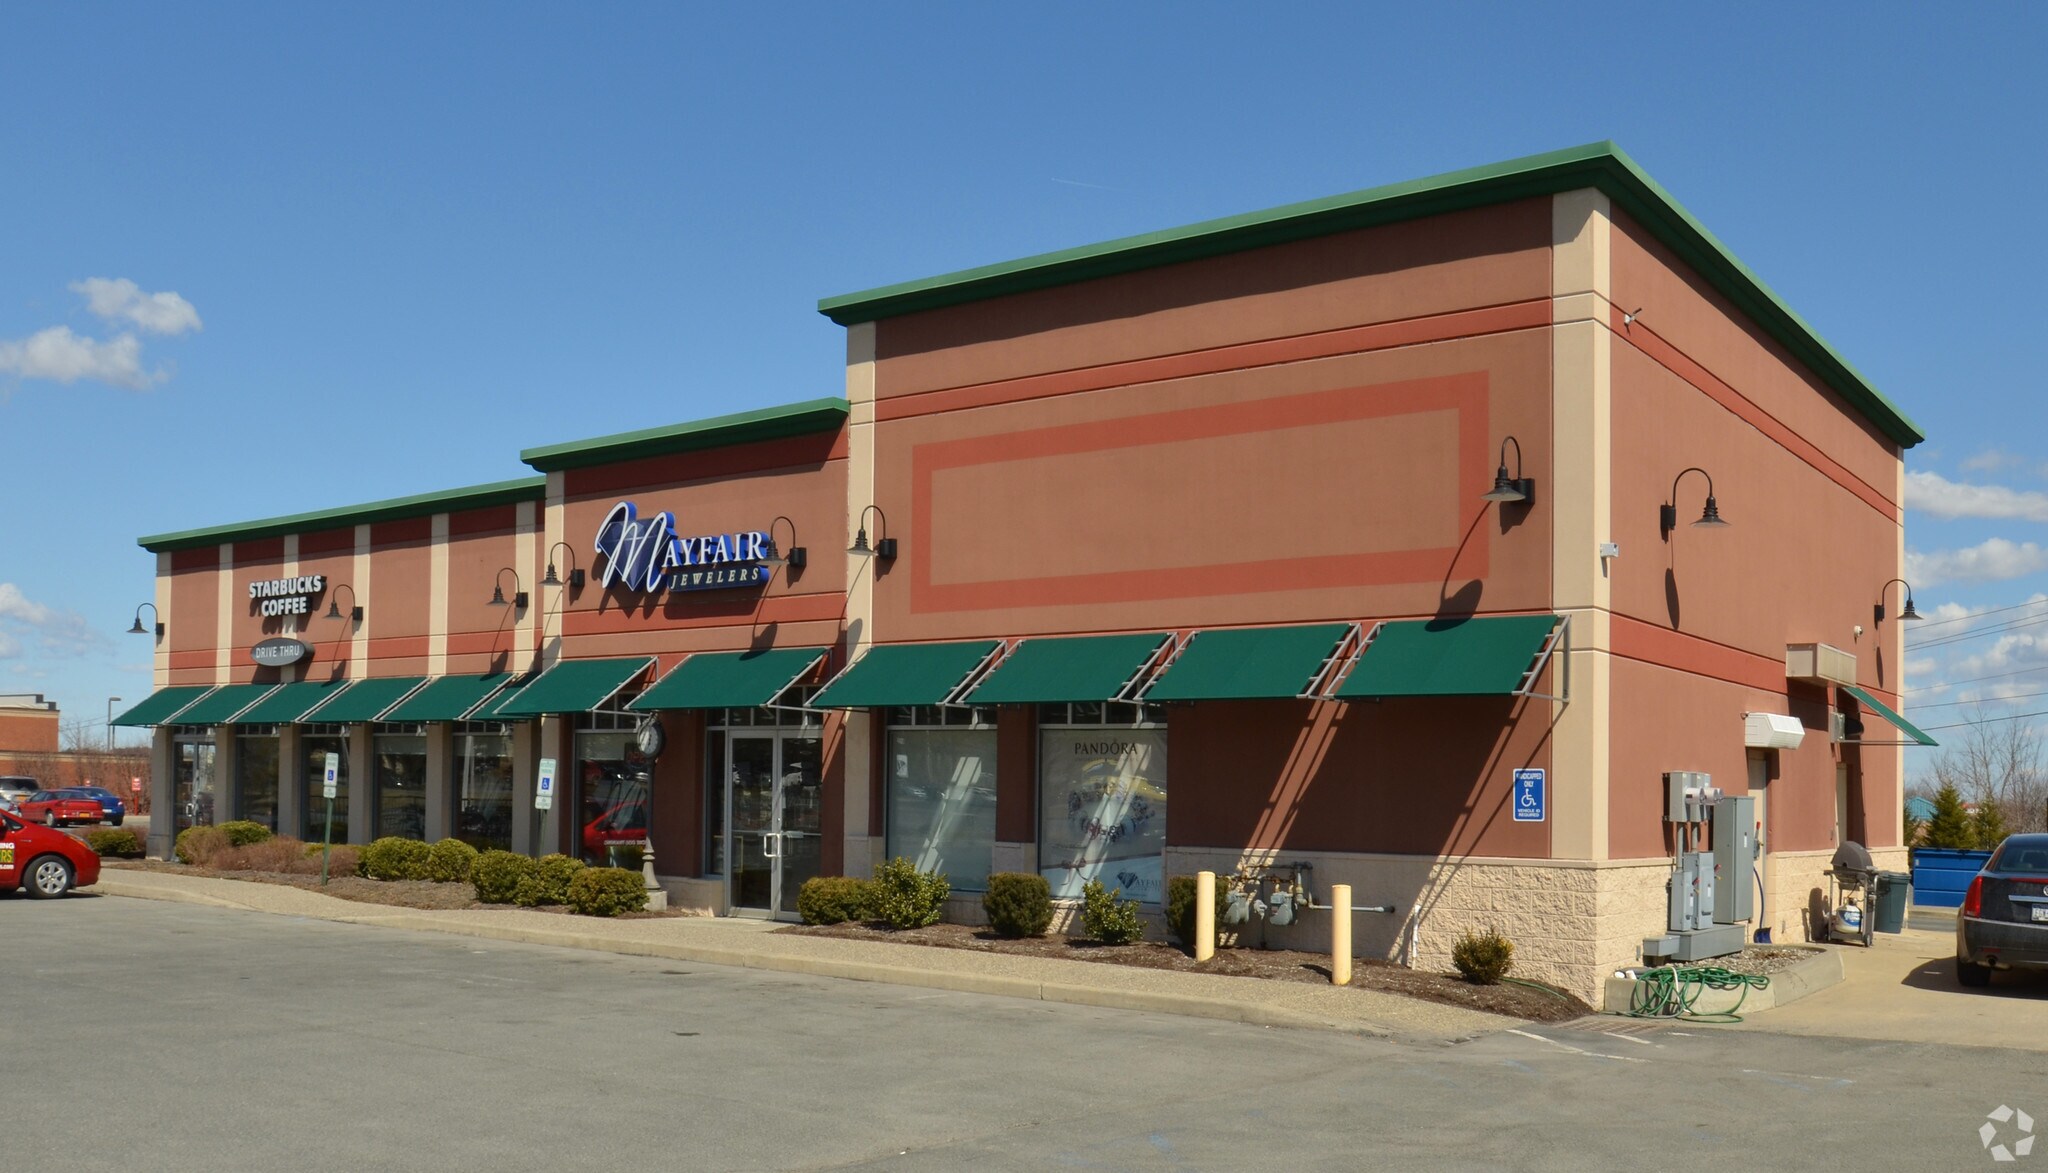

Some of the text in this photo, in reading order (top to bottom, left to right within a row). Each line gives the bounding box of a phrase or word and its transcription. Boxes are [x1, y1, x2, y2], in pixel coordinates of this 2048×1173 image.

[595, 502, 766, 593] MAYFAIR
[249, 575, 322, 599] STARBUCKS
[670, 567, 760, 589] JEWELERS
[261, 597, 307, 617] COFFEE
[255, 645, 300, 659] DRIVE THRU
[1074, 741, 1138, 755] PANDORA
